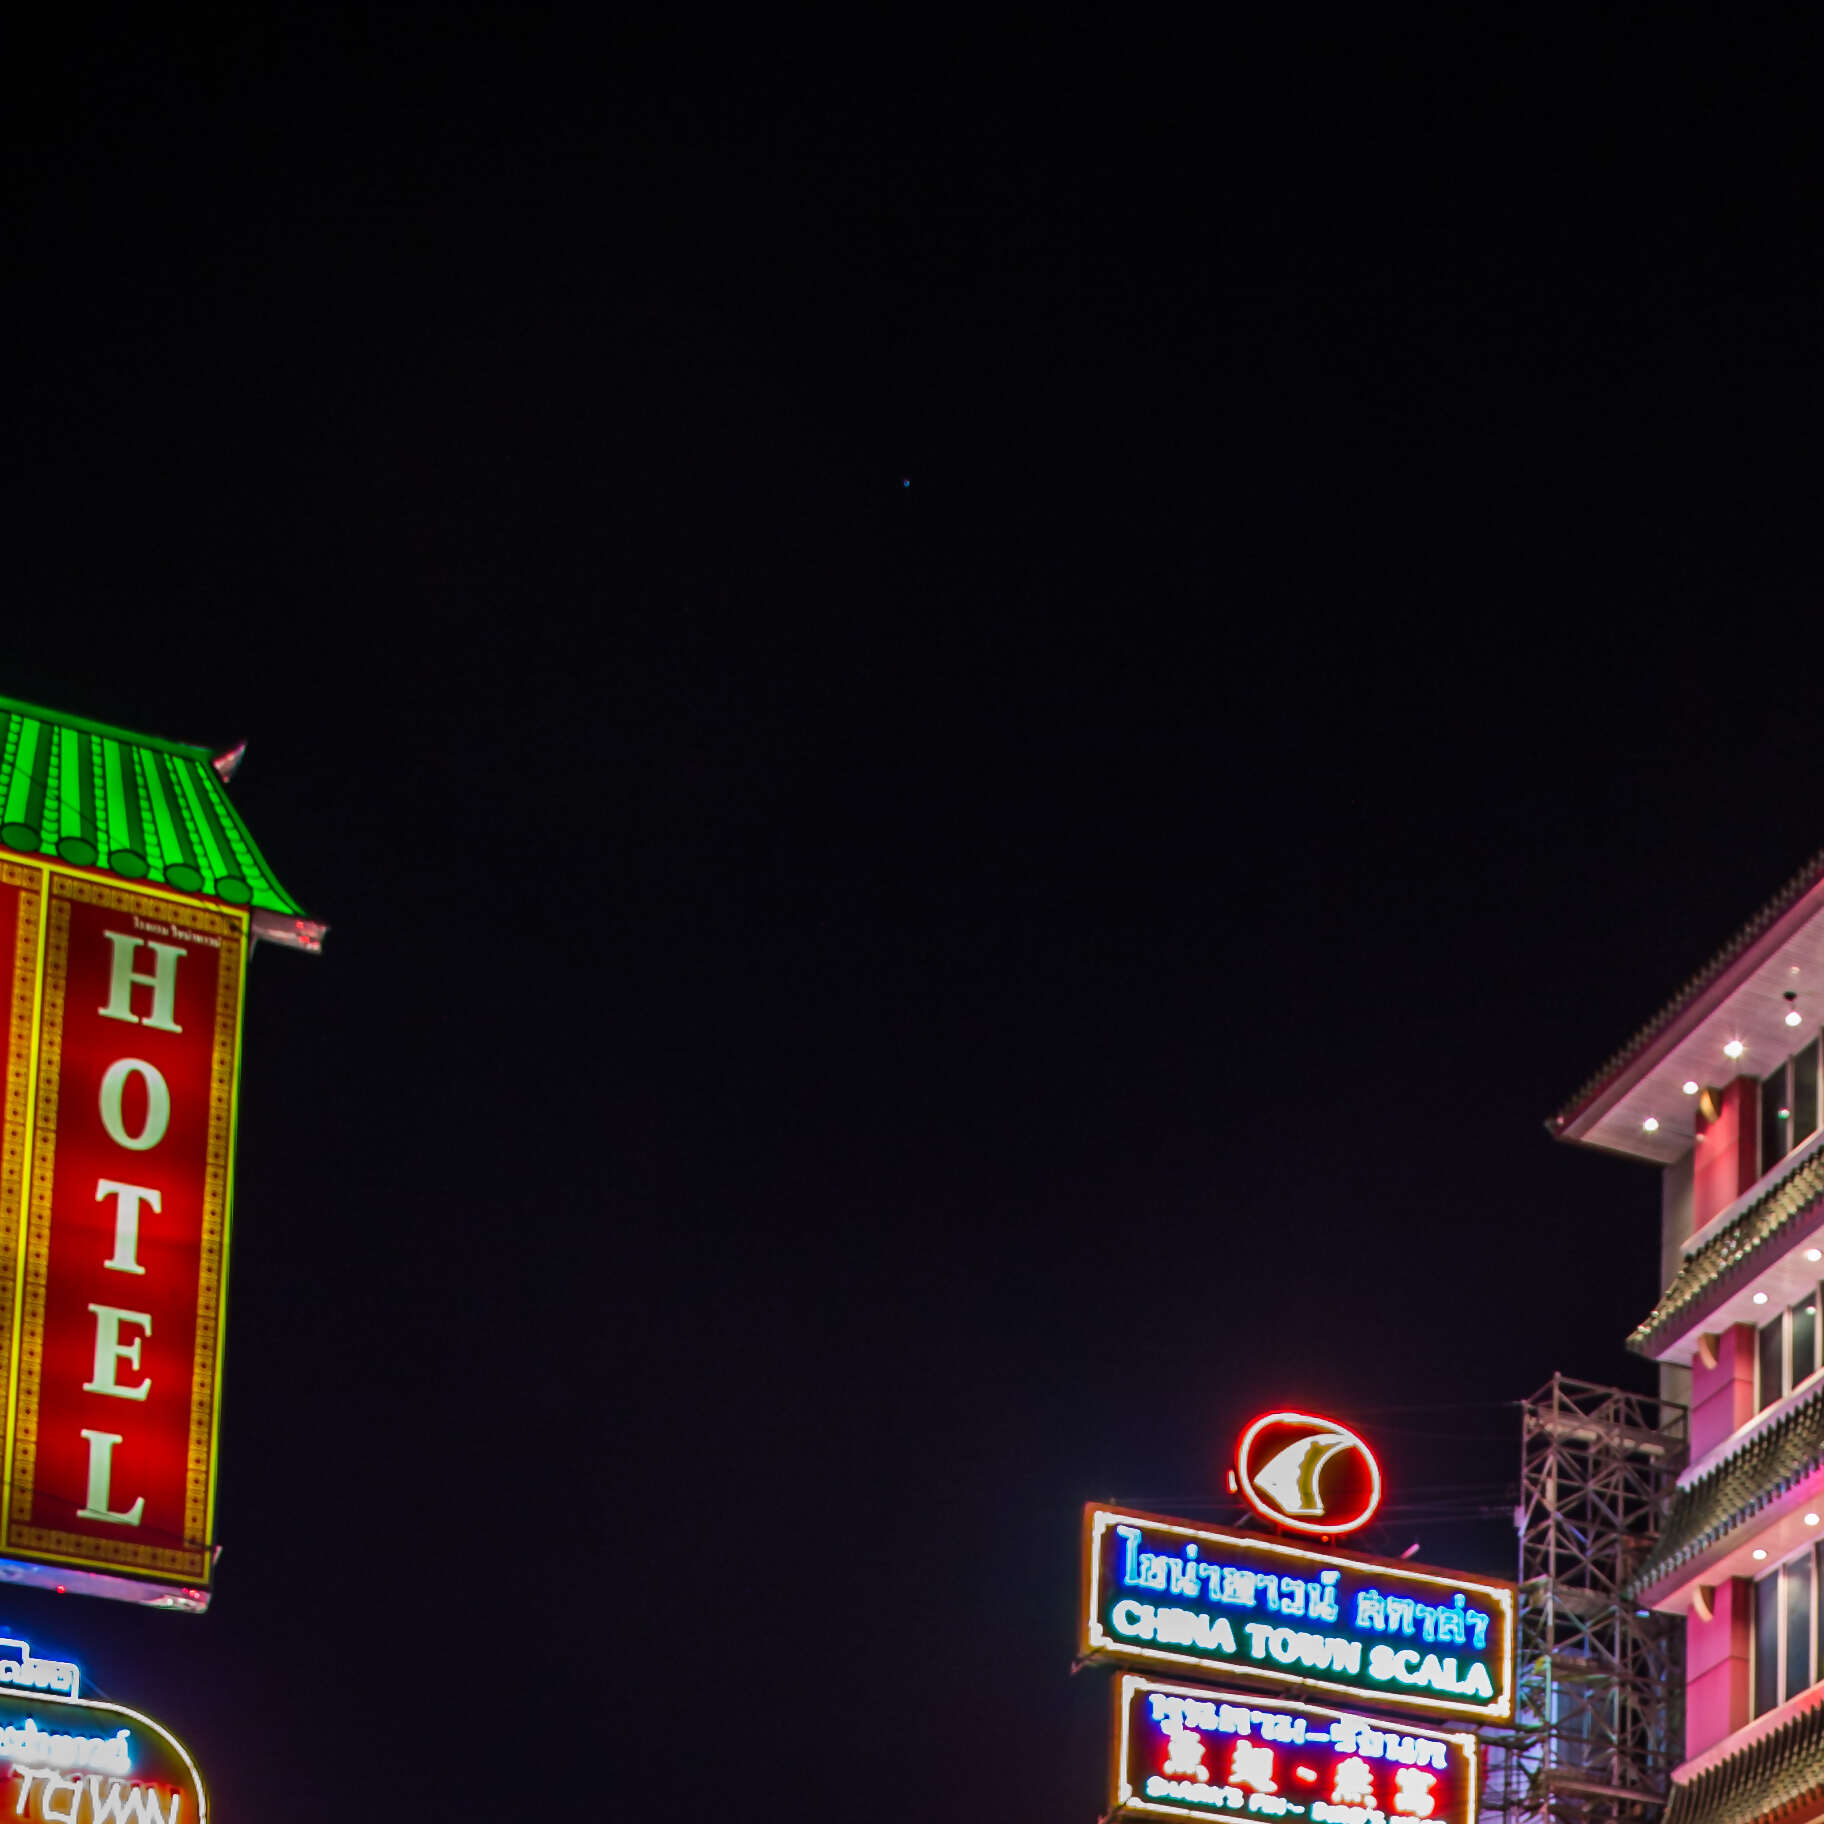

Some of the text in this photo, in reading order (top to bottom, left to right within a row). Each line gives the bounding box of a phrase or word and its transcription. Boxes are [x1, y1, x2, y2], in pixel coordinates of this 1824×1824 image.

[77, 930, 187, 1526] HOTEL
[1112, 1600, 1493, 1698] CHINA TOWN SCALA
